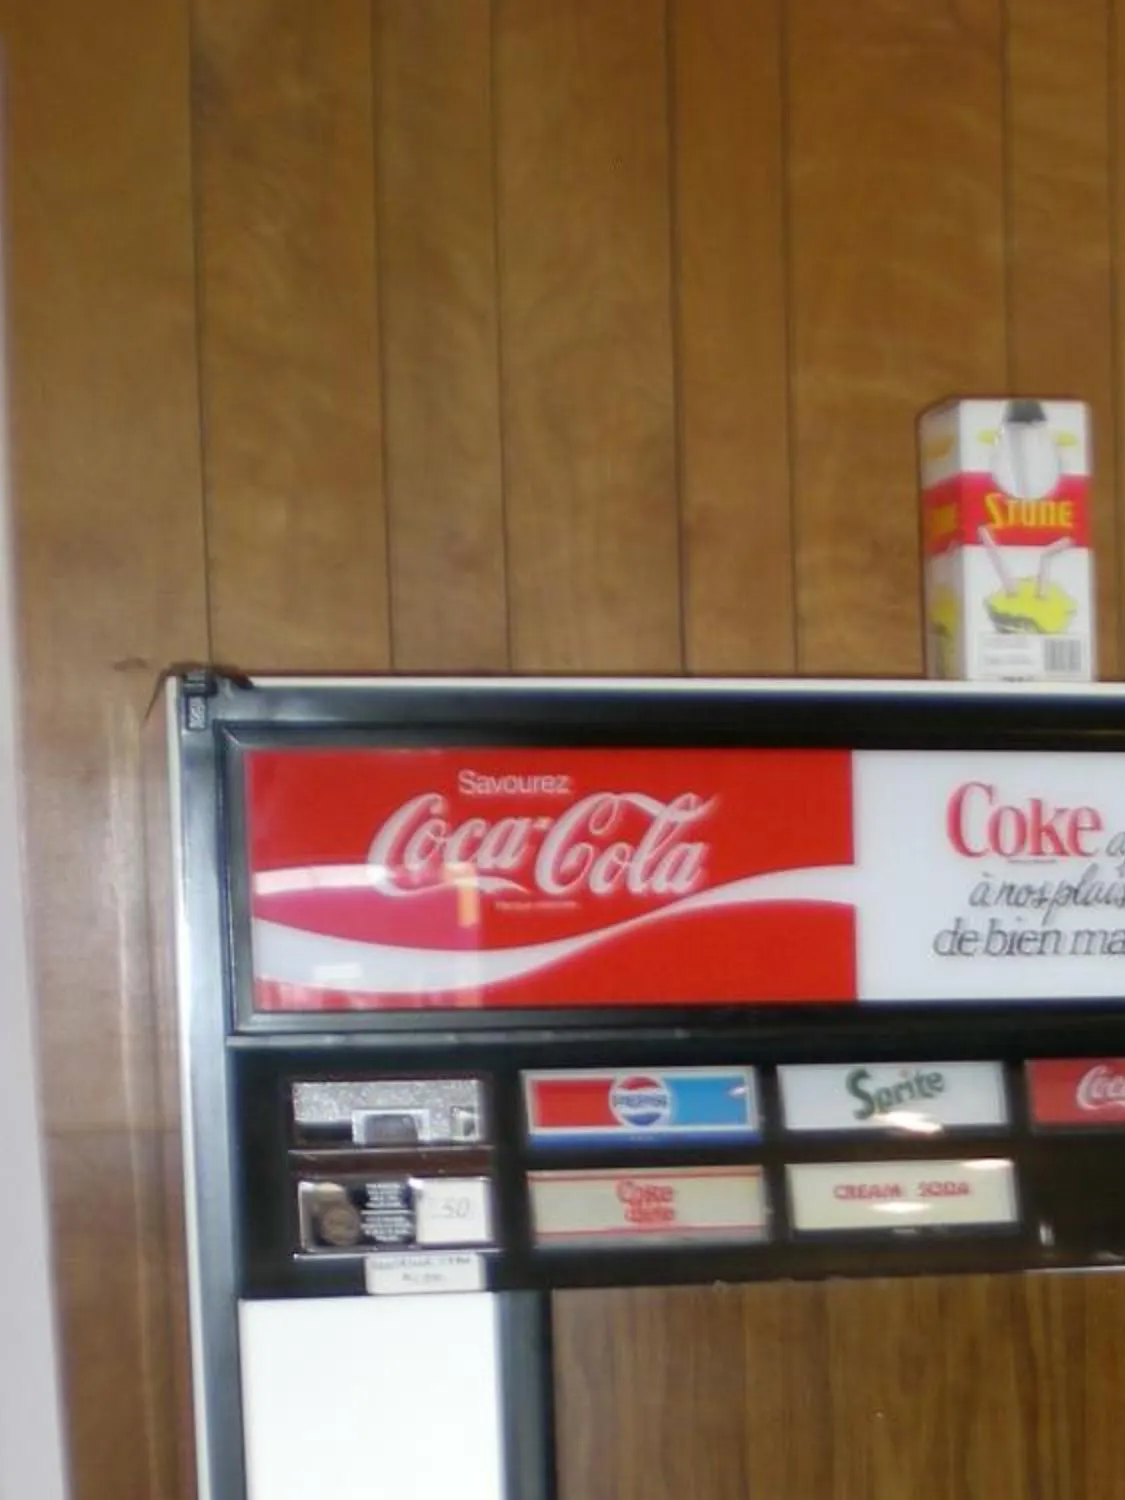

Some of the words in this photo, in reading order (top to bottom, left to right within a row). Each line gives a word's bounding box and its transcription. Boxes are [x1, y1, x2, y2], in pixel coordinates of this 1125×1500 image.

[458, 768, 570, 795] Savourez
[946, 780, 1105, 859] Coke
[367, 792, 720, 898] Coca-Cola
[967, 872, 991, 907] à
[994, 878, 1048, 907] nos
[932, 916, 979, 957] de
[982, 916, 1063, 957] bien
[845, 1067, 945, 1120] Sprite
[833, 1183, 904, 1200] CREAM
[917, 1181, 970, 1198] SODA
